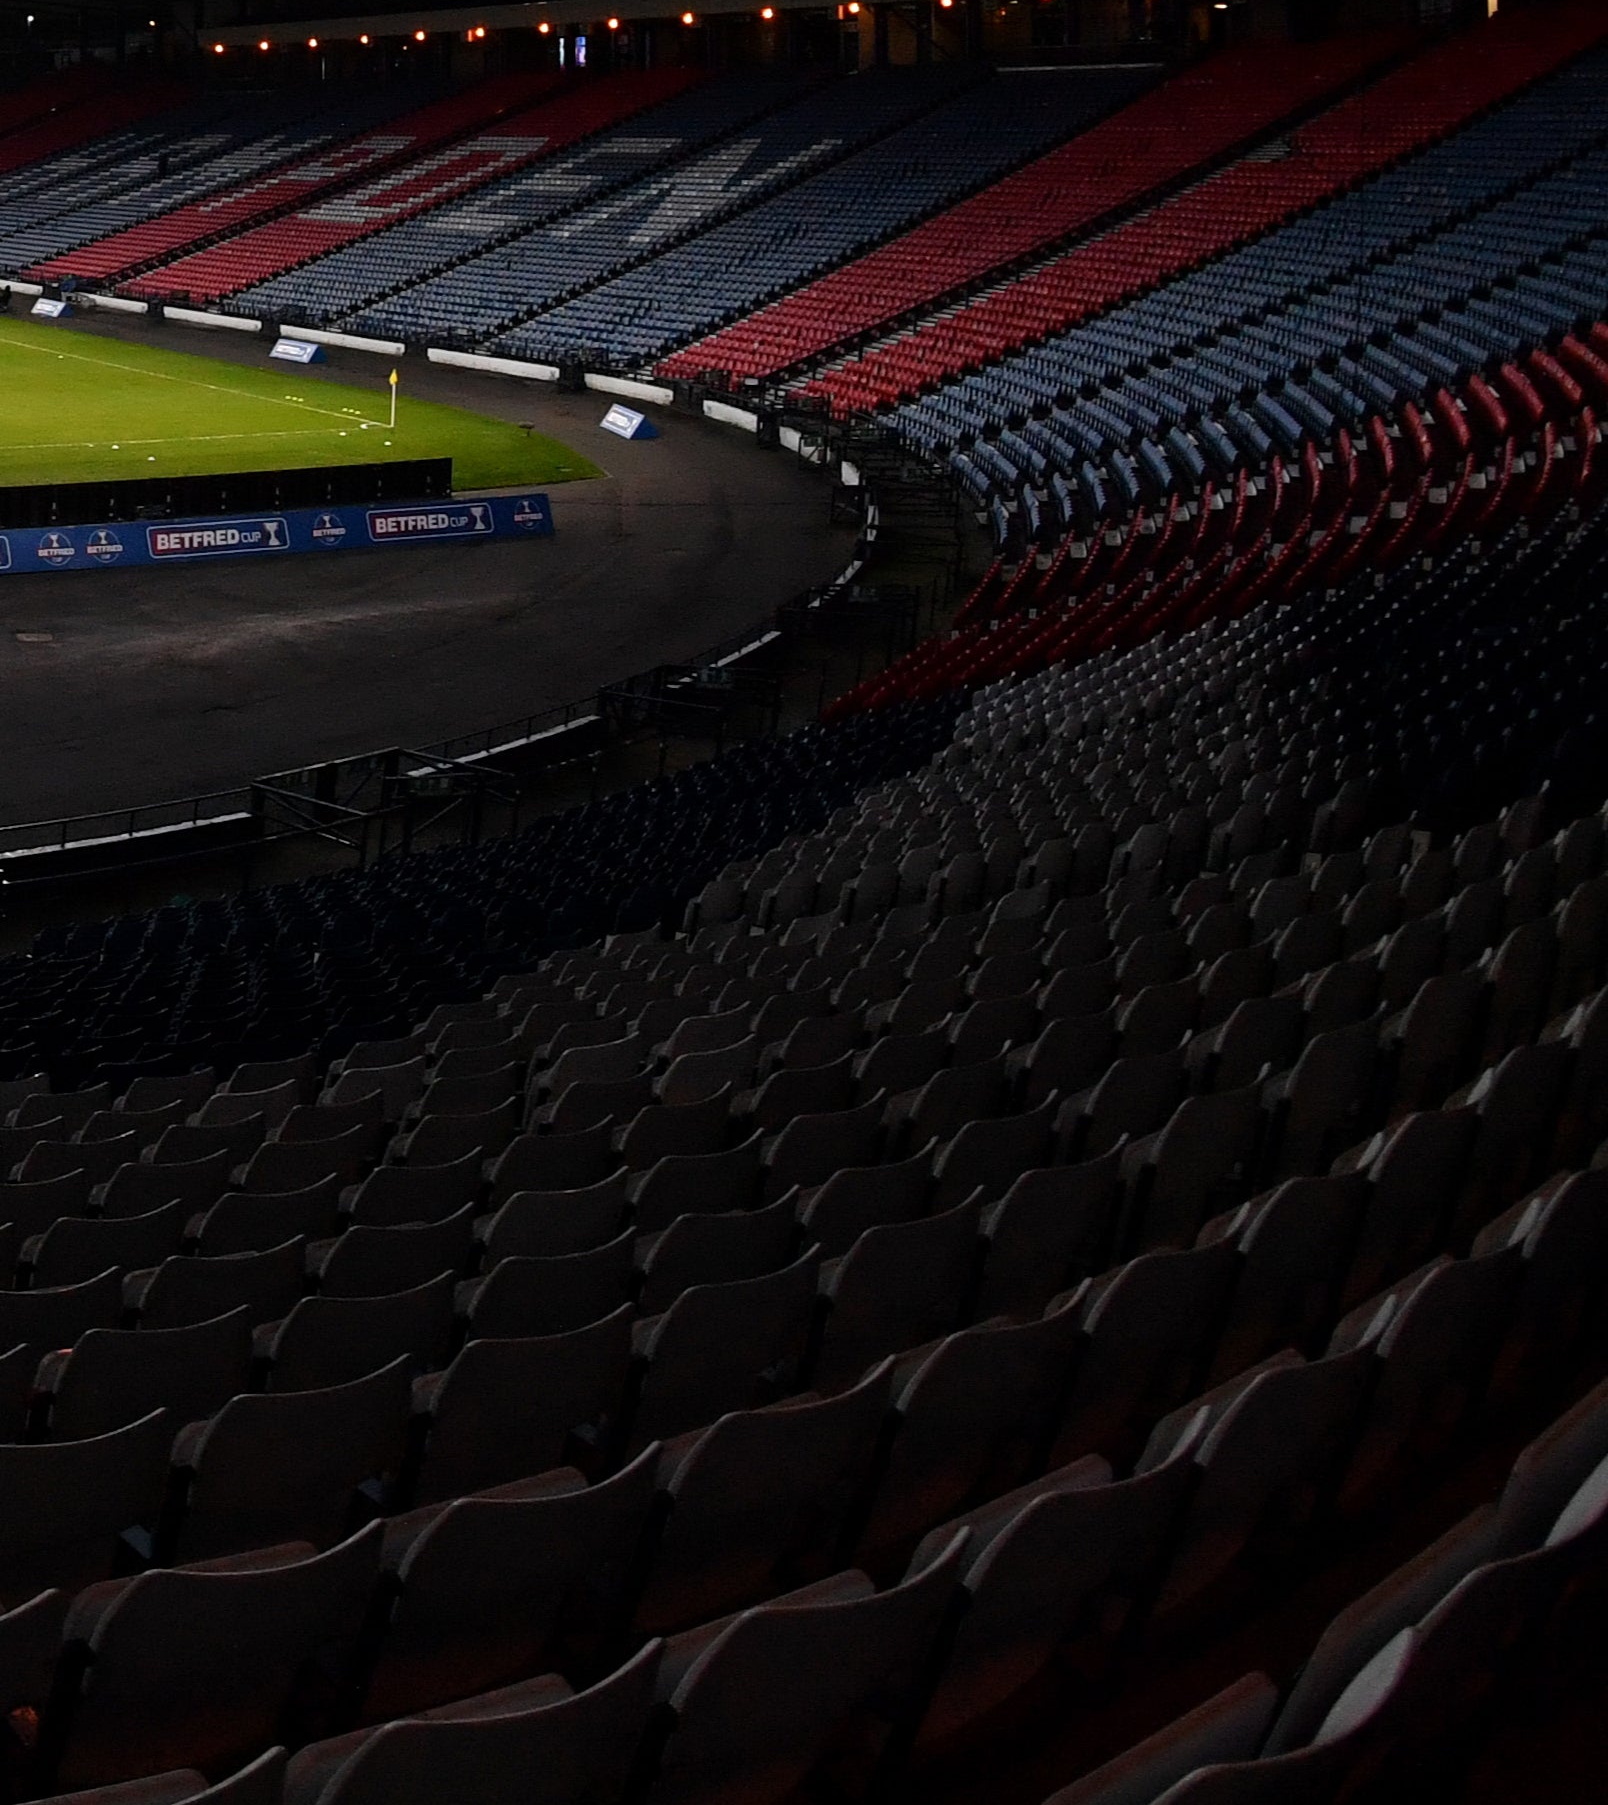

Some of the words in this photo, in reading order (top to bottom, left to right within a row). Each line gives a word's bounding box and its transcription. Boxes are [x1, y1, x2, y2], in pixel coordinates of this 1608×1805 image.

[375, 514, 450, 535] BETFRED
[450, 516, 468, 529] CUP
[156, 530, 240, 551] BETFRED
[241, 532, 262, 544] CUP
[313, 528, 346, 538] BETFRED
[86, 544, 123, 554] BETFRED
